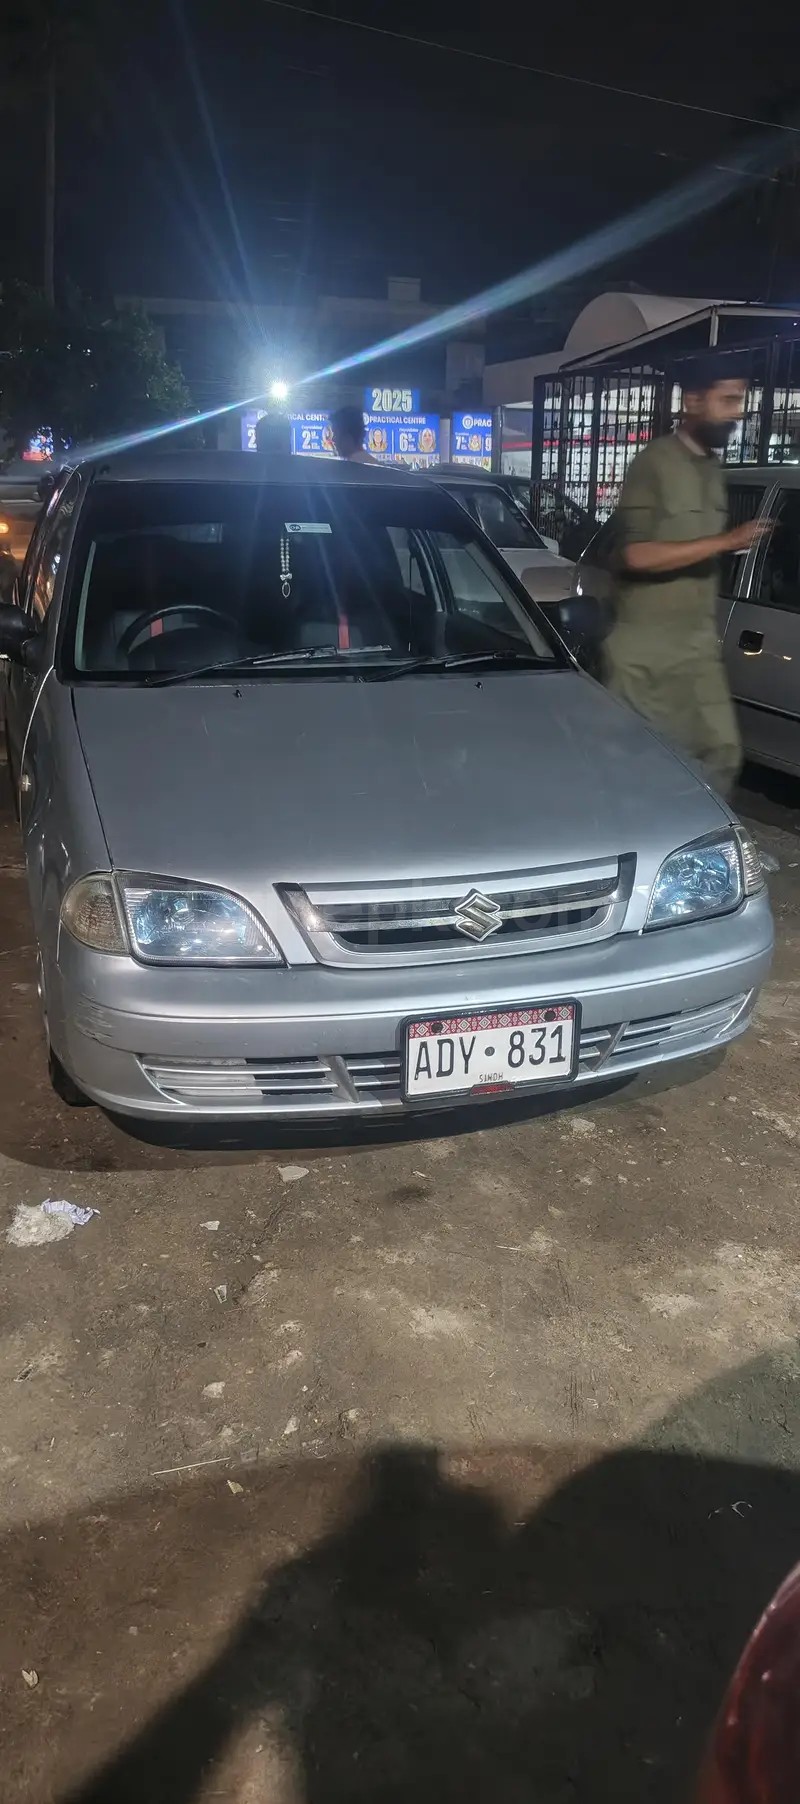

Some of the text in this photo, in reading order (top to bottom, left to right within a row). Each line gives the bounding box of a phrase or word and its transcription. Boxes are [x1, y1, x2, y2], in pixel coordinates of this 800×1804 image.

[372, 388, 412, 412] 2025
[370, 415, 426, 425] PRACTICAL CENTRE
[414, 1025, 566, 1081] ADY 831
[479, 1072, 504, 1083] SINDH
